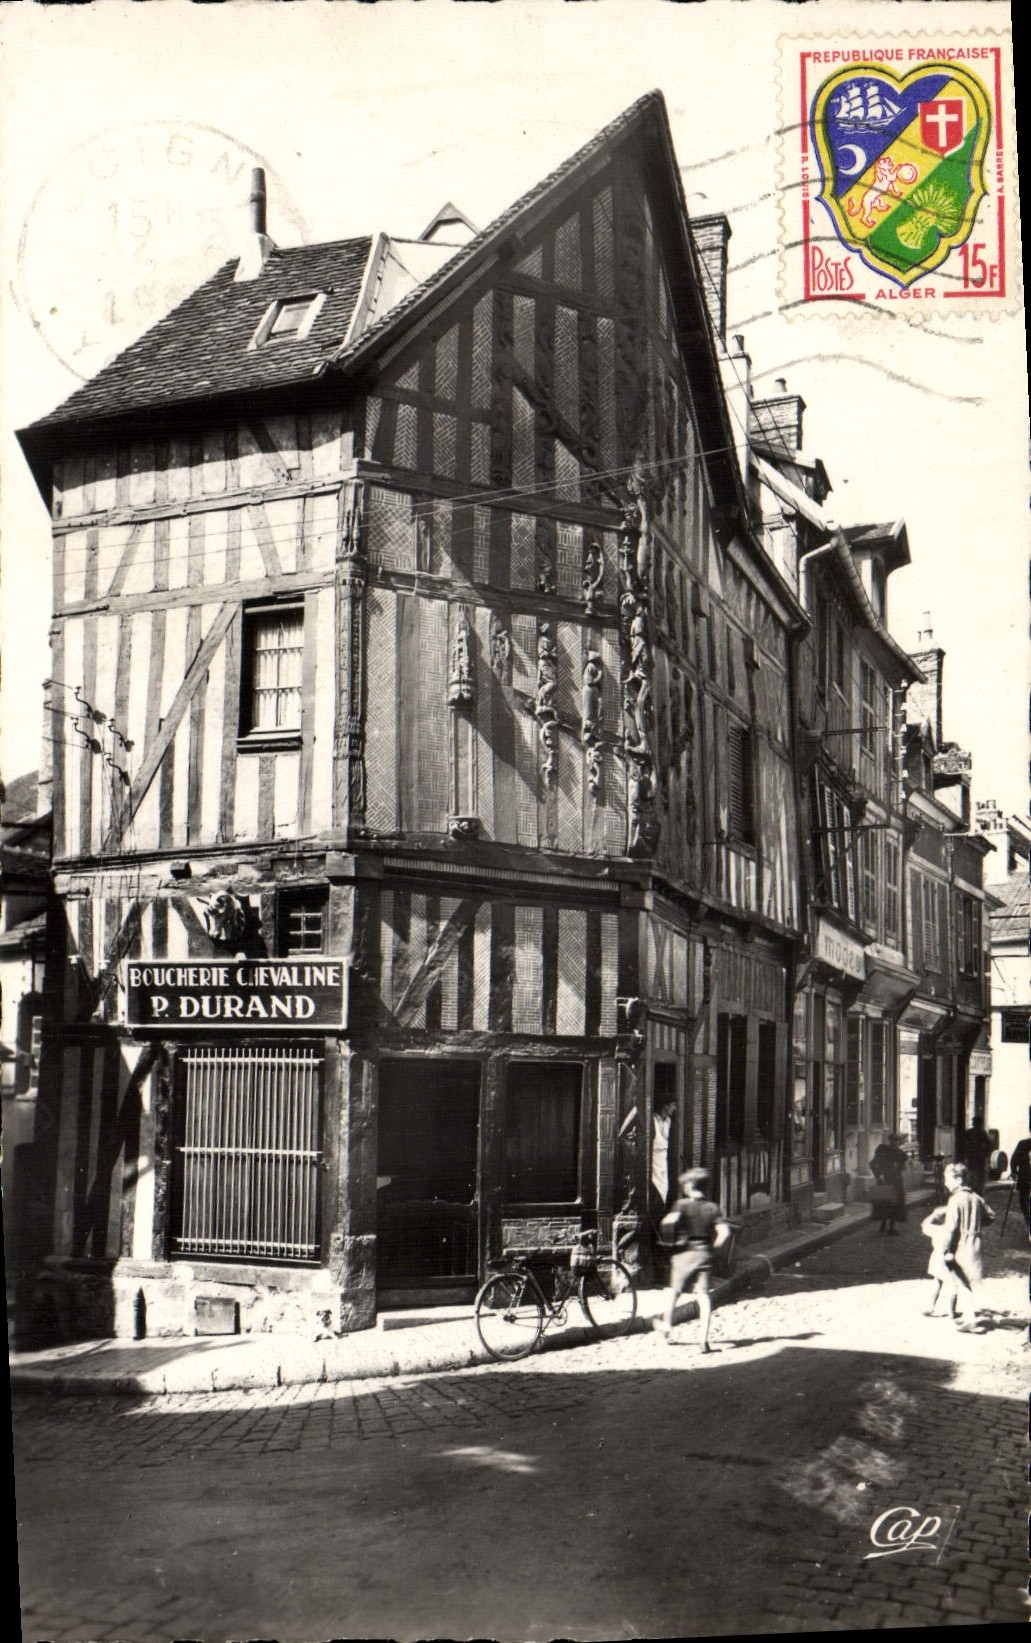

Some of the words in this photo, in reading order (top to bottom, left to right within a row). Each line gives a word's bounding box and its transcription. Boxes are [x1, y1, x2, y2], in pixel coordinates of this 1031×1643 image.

[129, 967, 229, 987] BOUCHERIE
[151, 996, 170, 1018] P.
[179, 995, 316, 1019] DURAND
